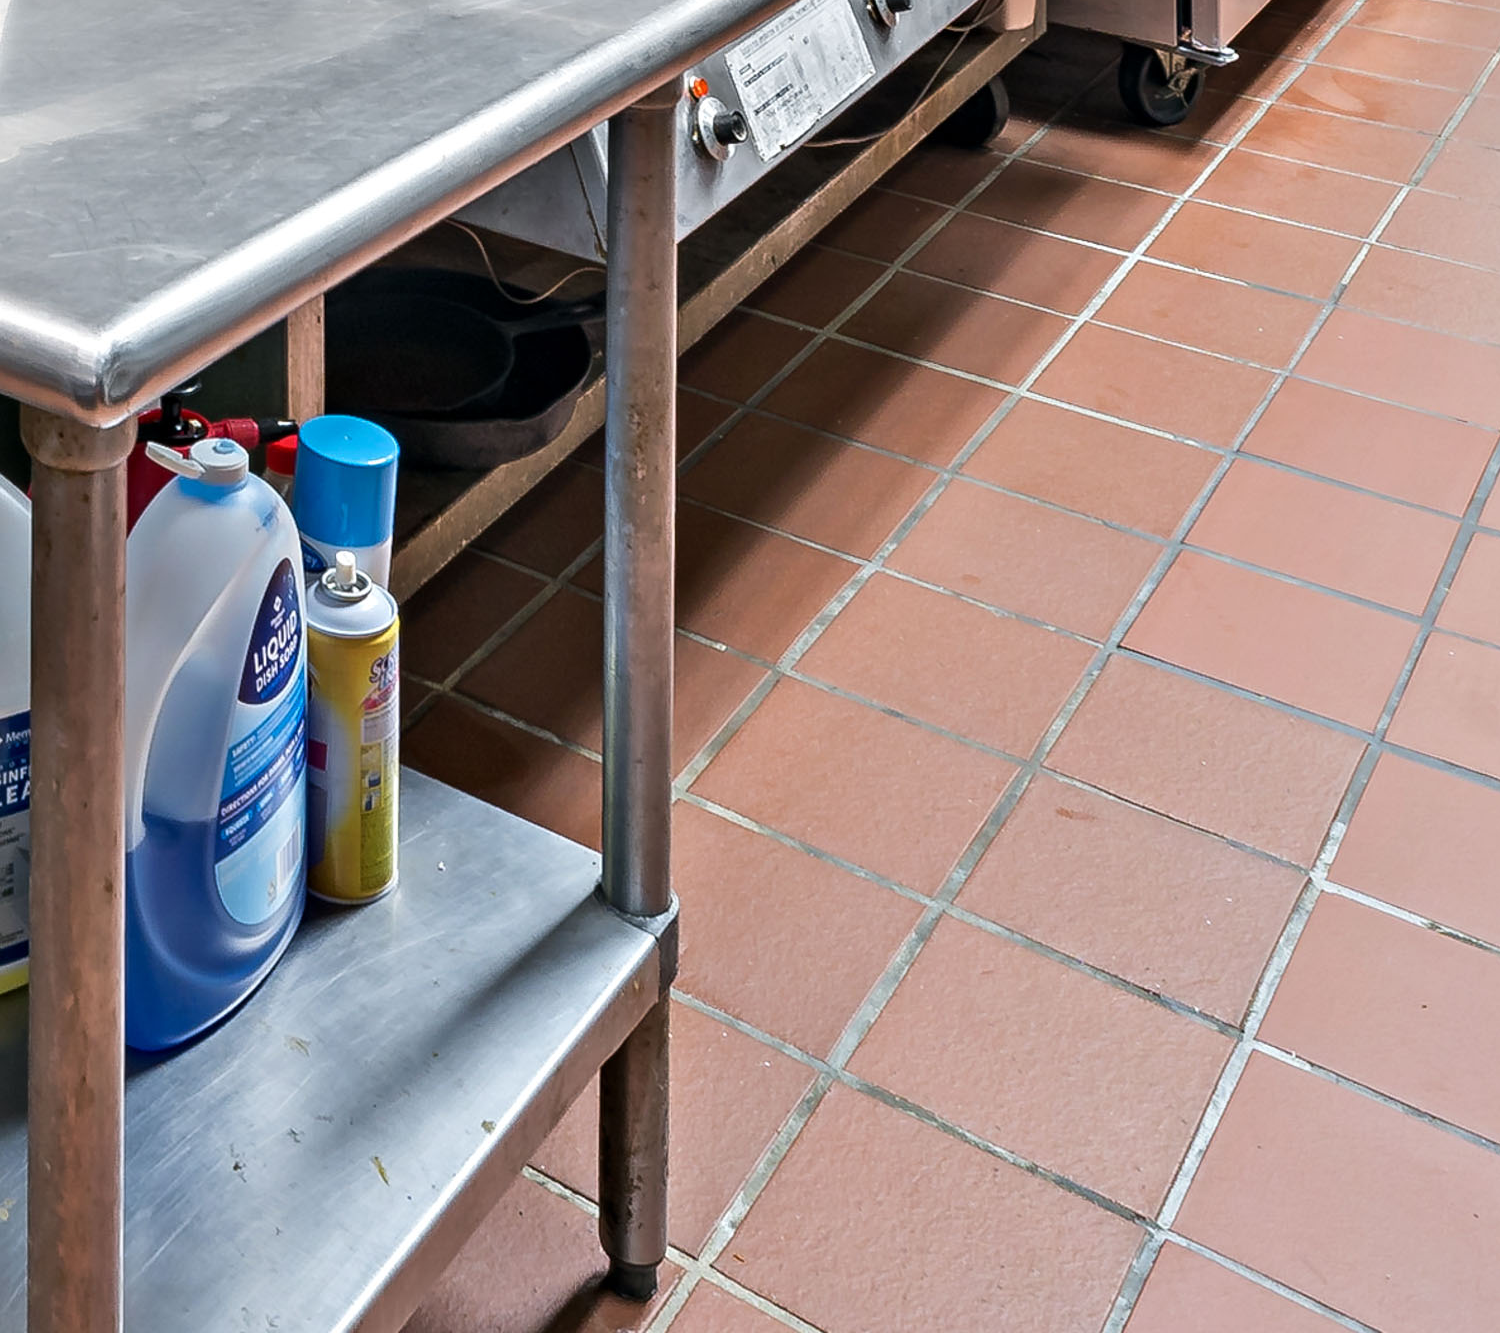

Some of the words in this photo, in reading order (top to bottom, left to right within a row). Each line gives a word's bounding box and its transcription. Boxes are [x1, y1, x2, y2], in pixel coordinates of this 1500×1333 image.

[253, 609, 298, 675] LIQUID
[255, 661, 279, 693] DISH
[279, 634, 299, 669] SOAP
[5, 728, 31, 744] Mem
